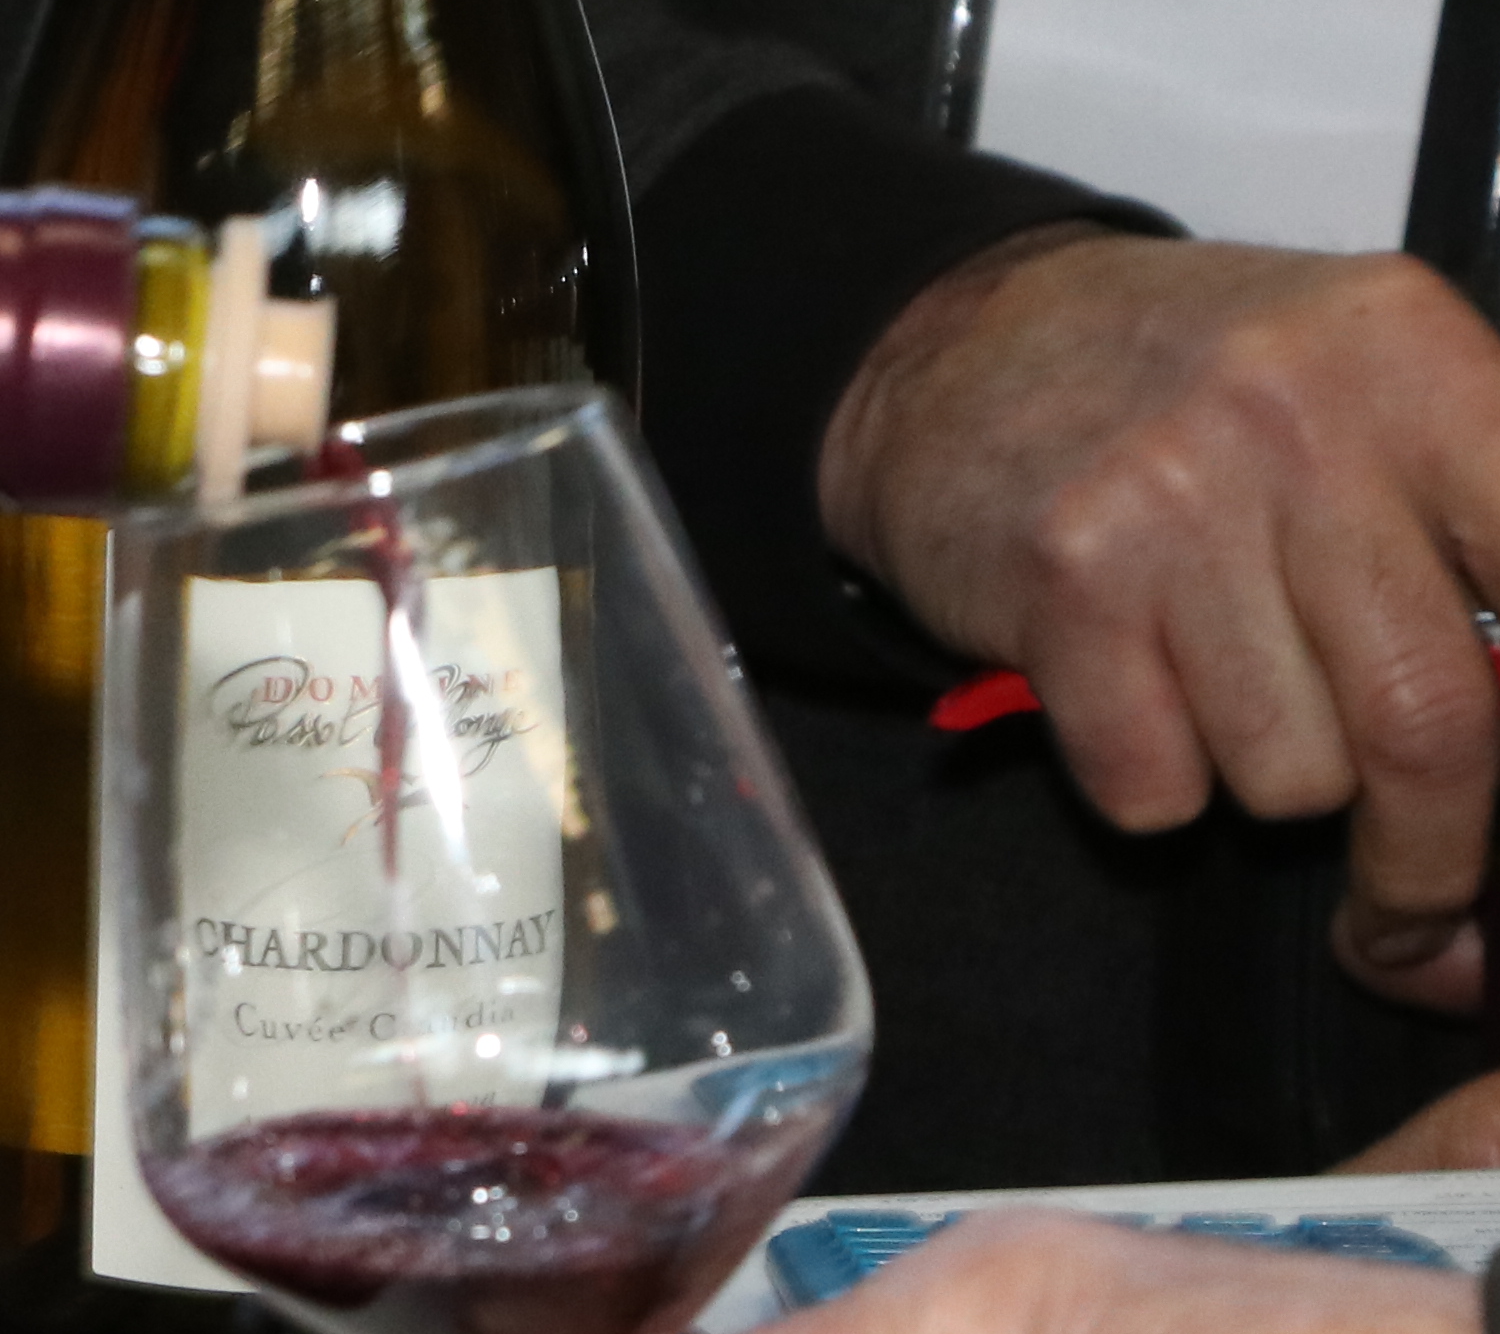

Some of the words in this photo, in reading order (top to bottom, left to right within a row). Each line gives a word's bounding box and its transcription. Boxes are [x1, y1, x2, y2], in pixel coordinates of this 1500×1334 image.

[262, 669, 519, 704] DOMINE
[196, 910, 555, 971] CHARDONNAY
[234, 1001, 348, 1041] Cuvée
